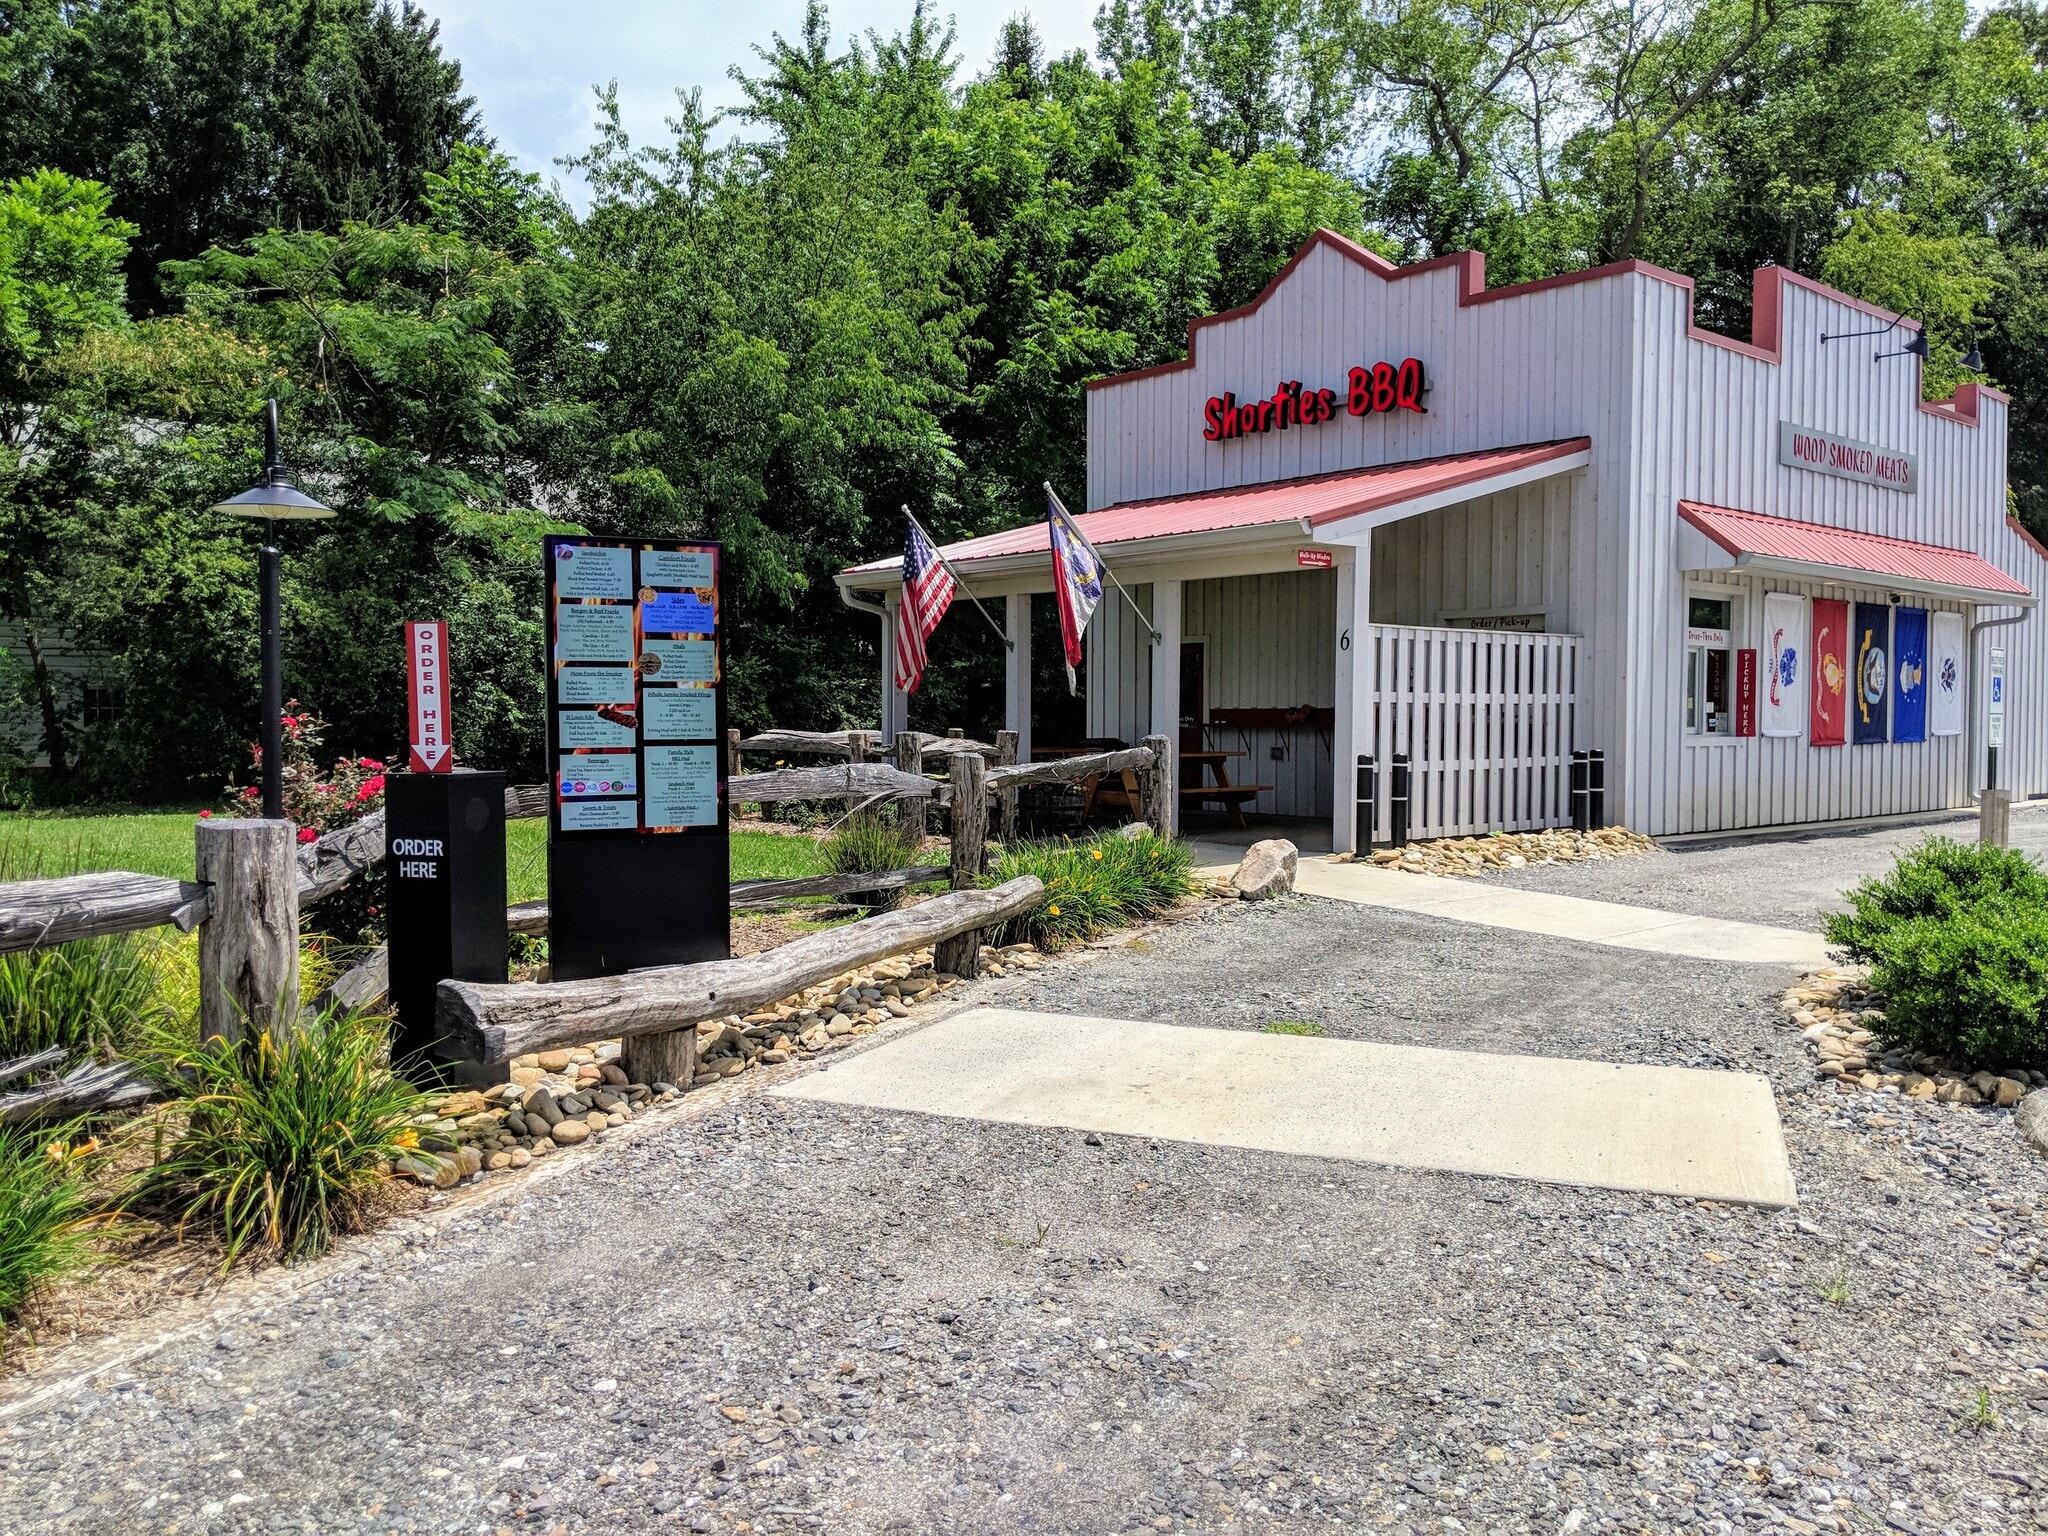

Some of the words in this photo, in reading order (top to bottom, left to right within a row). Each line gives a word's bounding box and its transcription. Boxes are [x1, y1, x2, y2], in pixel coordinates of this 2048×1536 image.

[1203, 380, 1337, 441] Shorties
[1348, 358, 1428, 417] BBQ
[1793, 433, 1827, 464] WOOD
[1829, 442, 1873, 475] SMOKED
[1875, 455, 1909, 484] MEATS
[1470, 618, 1491, 628] Order
[1500, 616, 1530, 628] Pick-up
[1340, 628, 1350, 652] 6
[1713, 632, 1724, 644] Only
[419, 630, 434, 695] ORDER
[1742, 653, 1751, 699] PICKUP
[423, 710, 437, 760] HERE
[1742, 704, 1750, 735] HERE
[392, 838, 444, 857] ORDER
[399, 861, 438, 879] HERE
